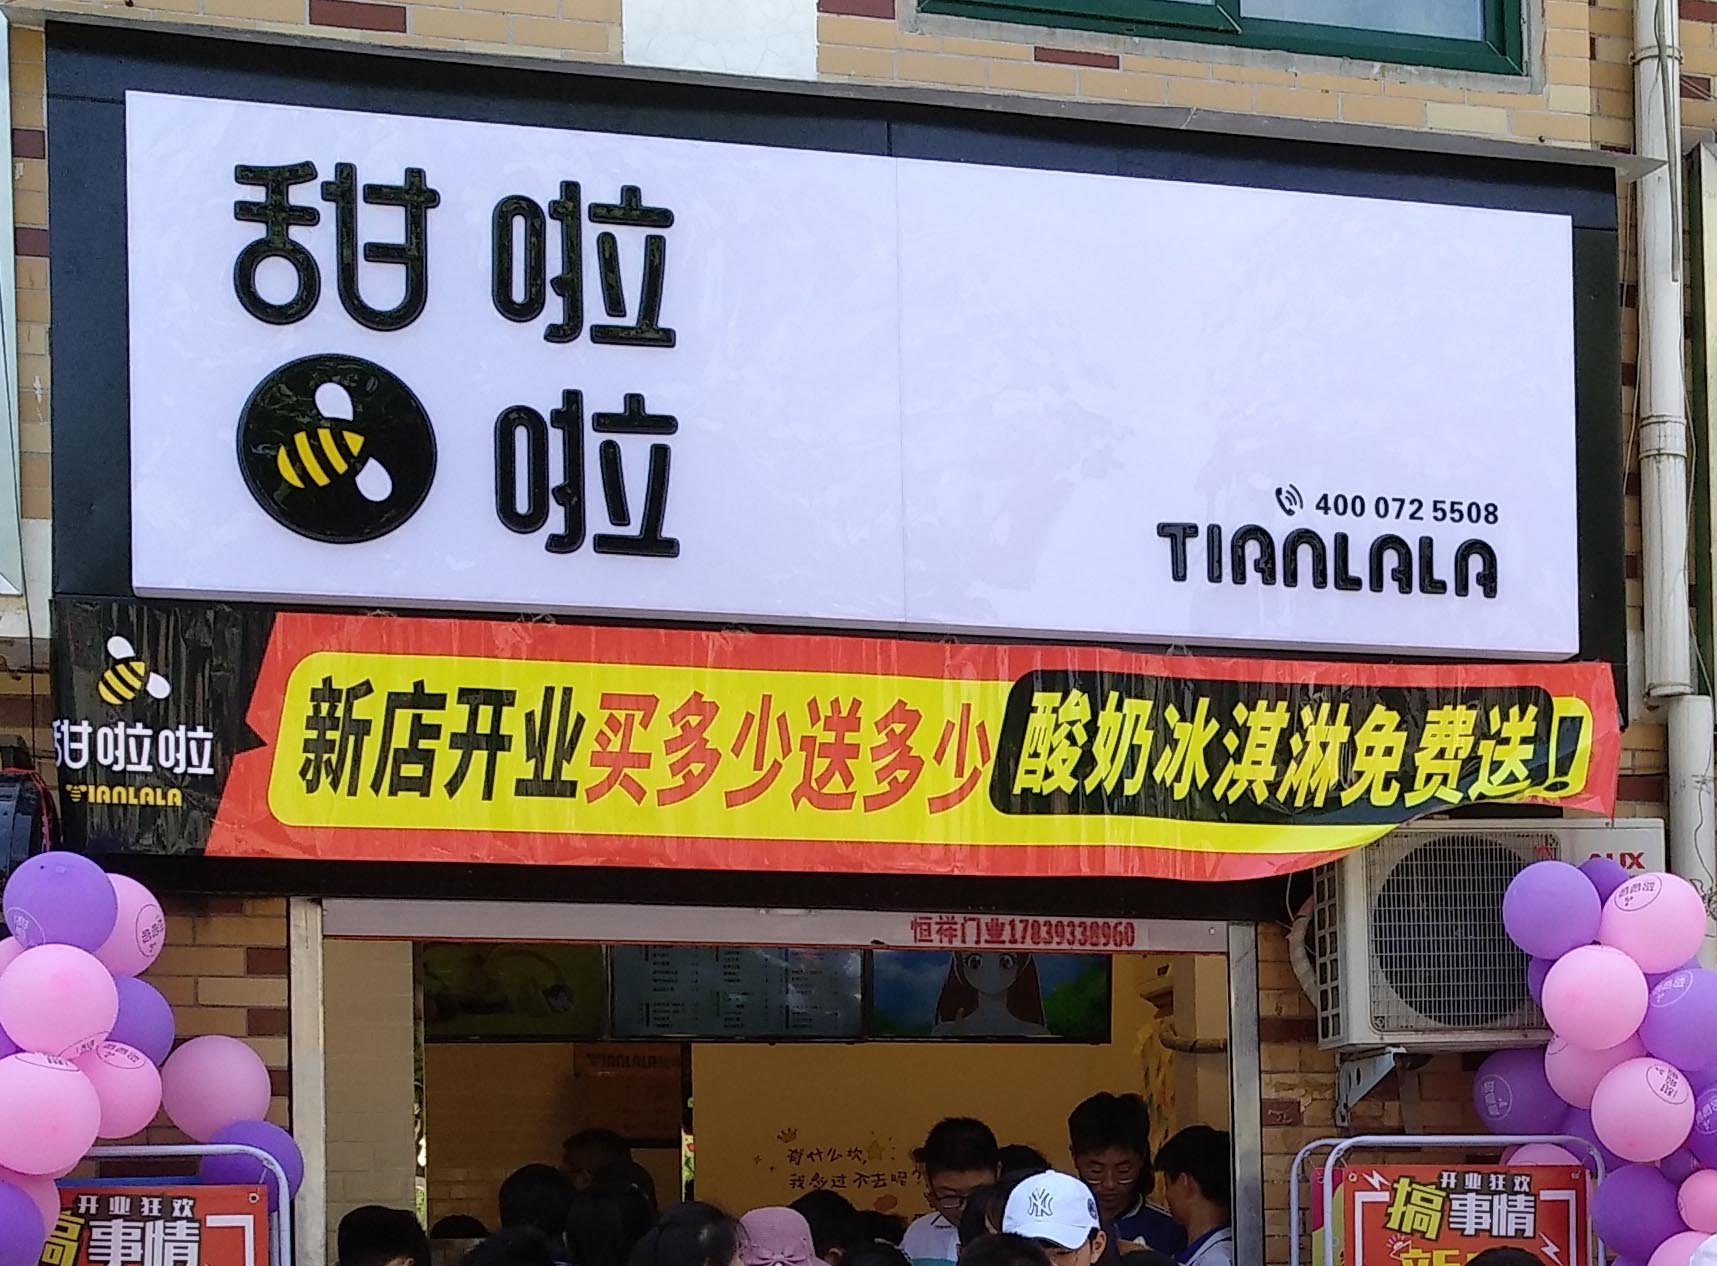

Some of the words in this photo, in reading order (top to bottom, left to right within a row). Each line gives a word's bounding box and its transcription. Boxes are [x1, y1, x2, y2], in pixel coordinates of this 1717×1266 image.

[1315, 493, 1366, 517] 400
[1375, 496, 1424, 521] 072
[1432, 500, 1499, 525] 5508
[1156, 522, 1498, 599] TIANLALA
[1440, 1170, 1531, 1193] 开业狂欢
[77, 1194, 196, 1218] 开业狂欢
[1386, 1177, 1536, 1240] 搞事情
